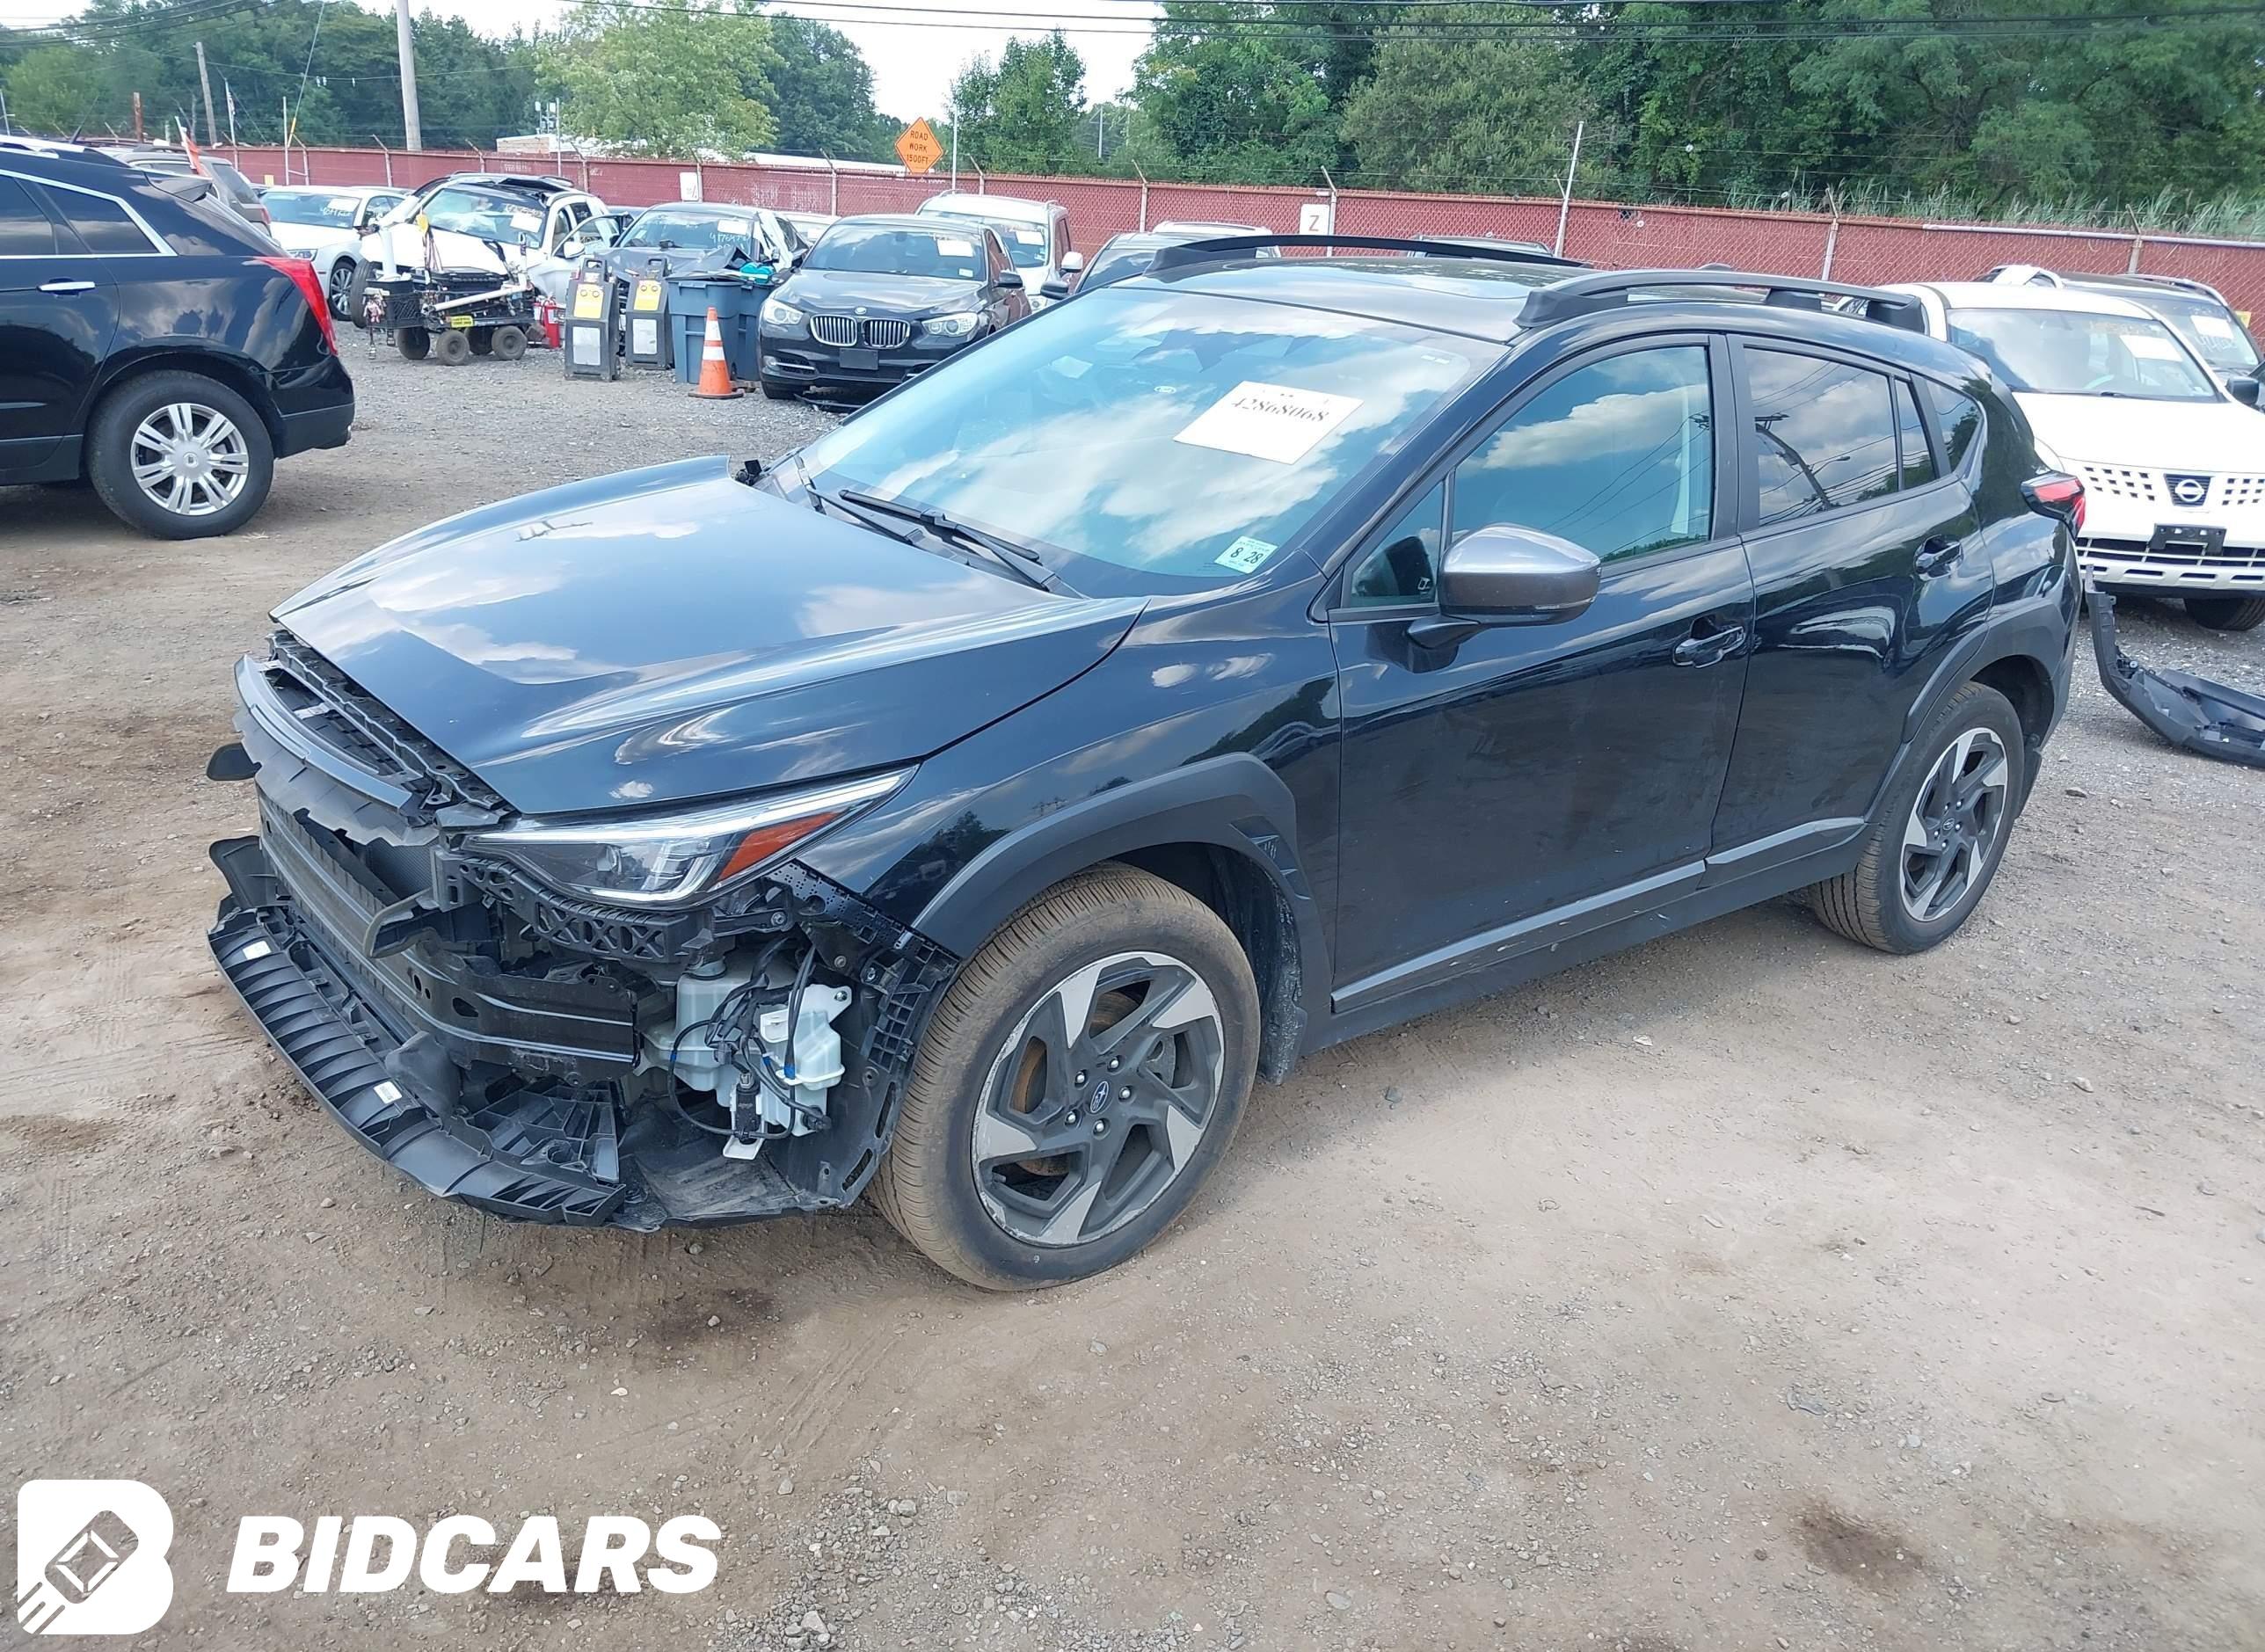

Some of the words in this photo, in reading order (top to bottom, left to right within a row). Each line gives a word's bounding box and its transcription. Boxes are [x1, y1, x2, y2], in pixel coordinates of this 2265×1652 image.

[910, 130, 929, 141] ROAD
[909, 142, 928, 153] WORK
[1308, 215, 1320, 232] Z
[1231, 397, 1329, 422] 42868068
[1230, 547, 1244, 558] 8
[1243, 551, 1264, 564] 28
